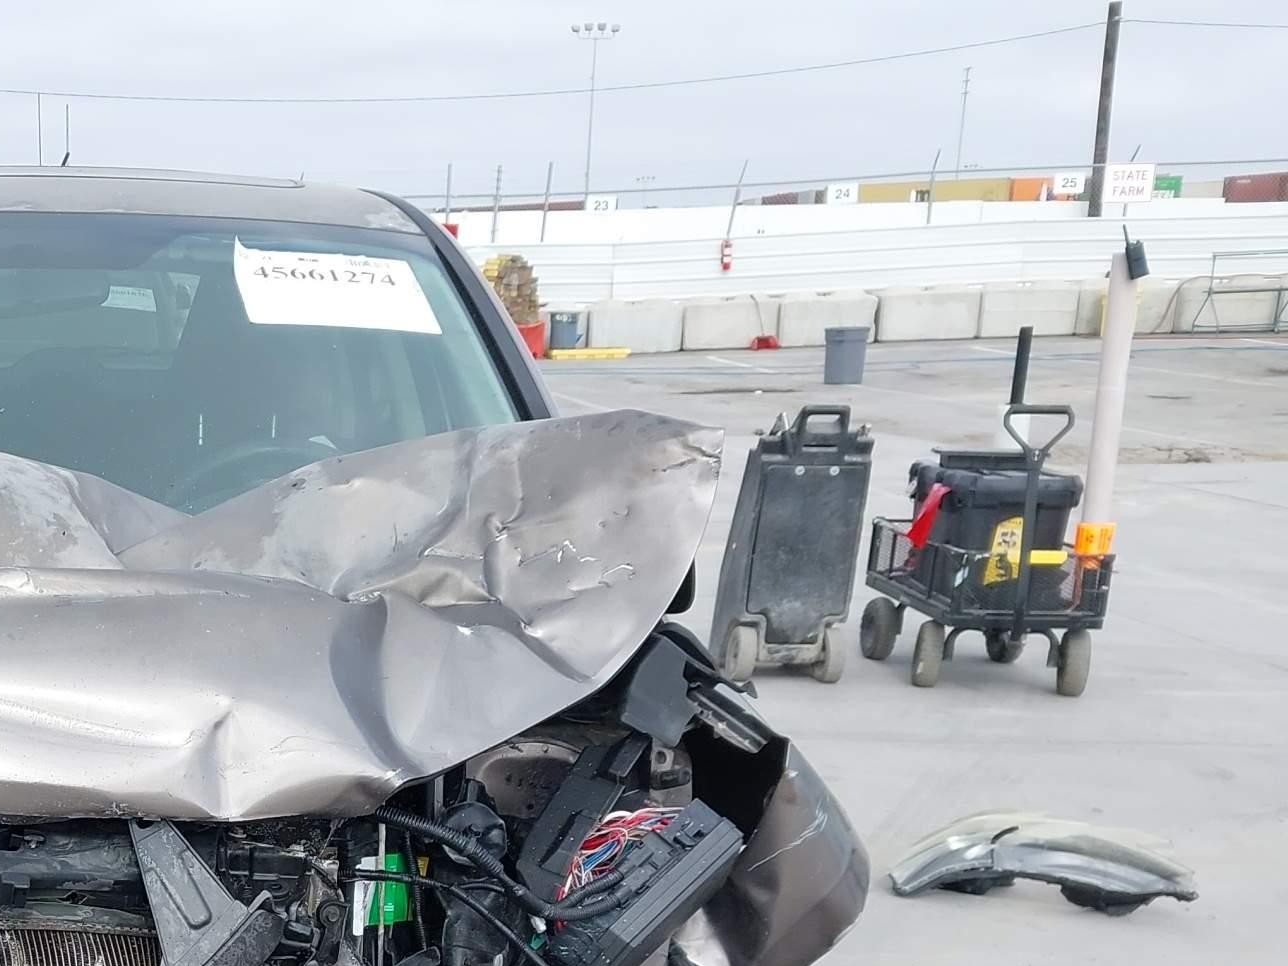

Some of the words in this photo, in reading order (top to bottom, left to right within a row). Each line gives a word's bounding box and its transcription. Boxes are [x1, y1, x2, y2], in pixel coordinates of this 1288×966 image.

[1112, 169, 1149, 182] STATE
[1061, 177, 1077, 189] 25
[835, 189, 851, 200] 24
[1112, 185, 1145, 197] FARM
[593, 200, 609, 211] 23
[253, 265, 397, 287] 45661274
